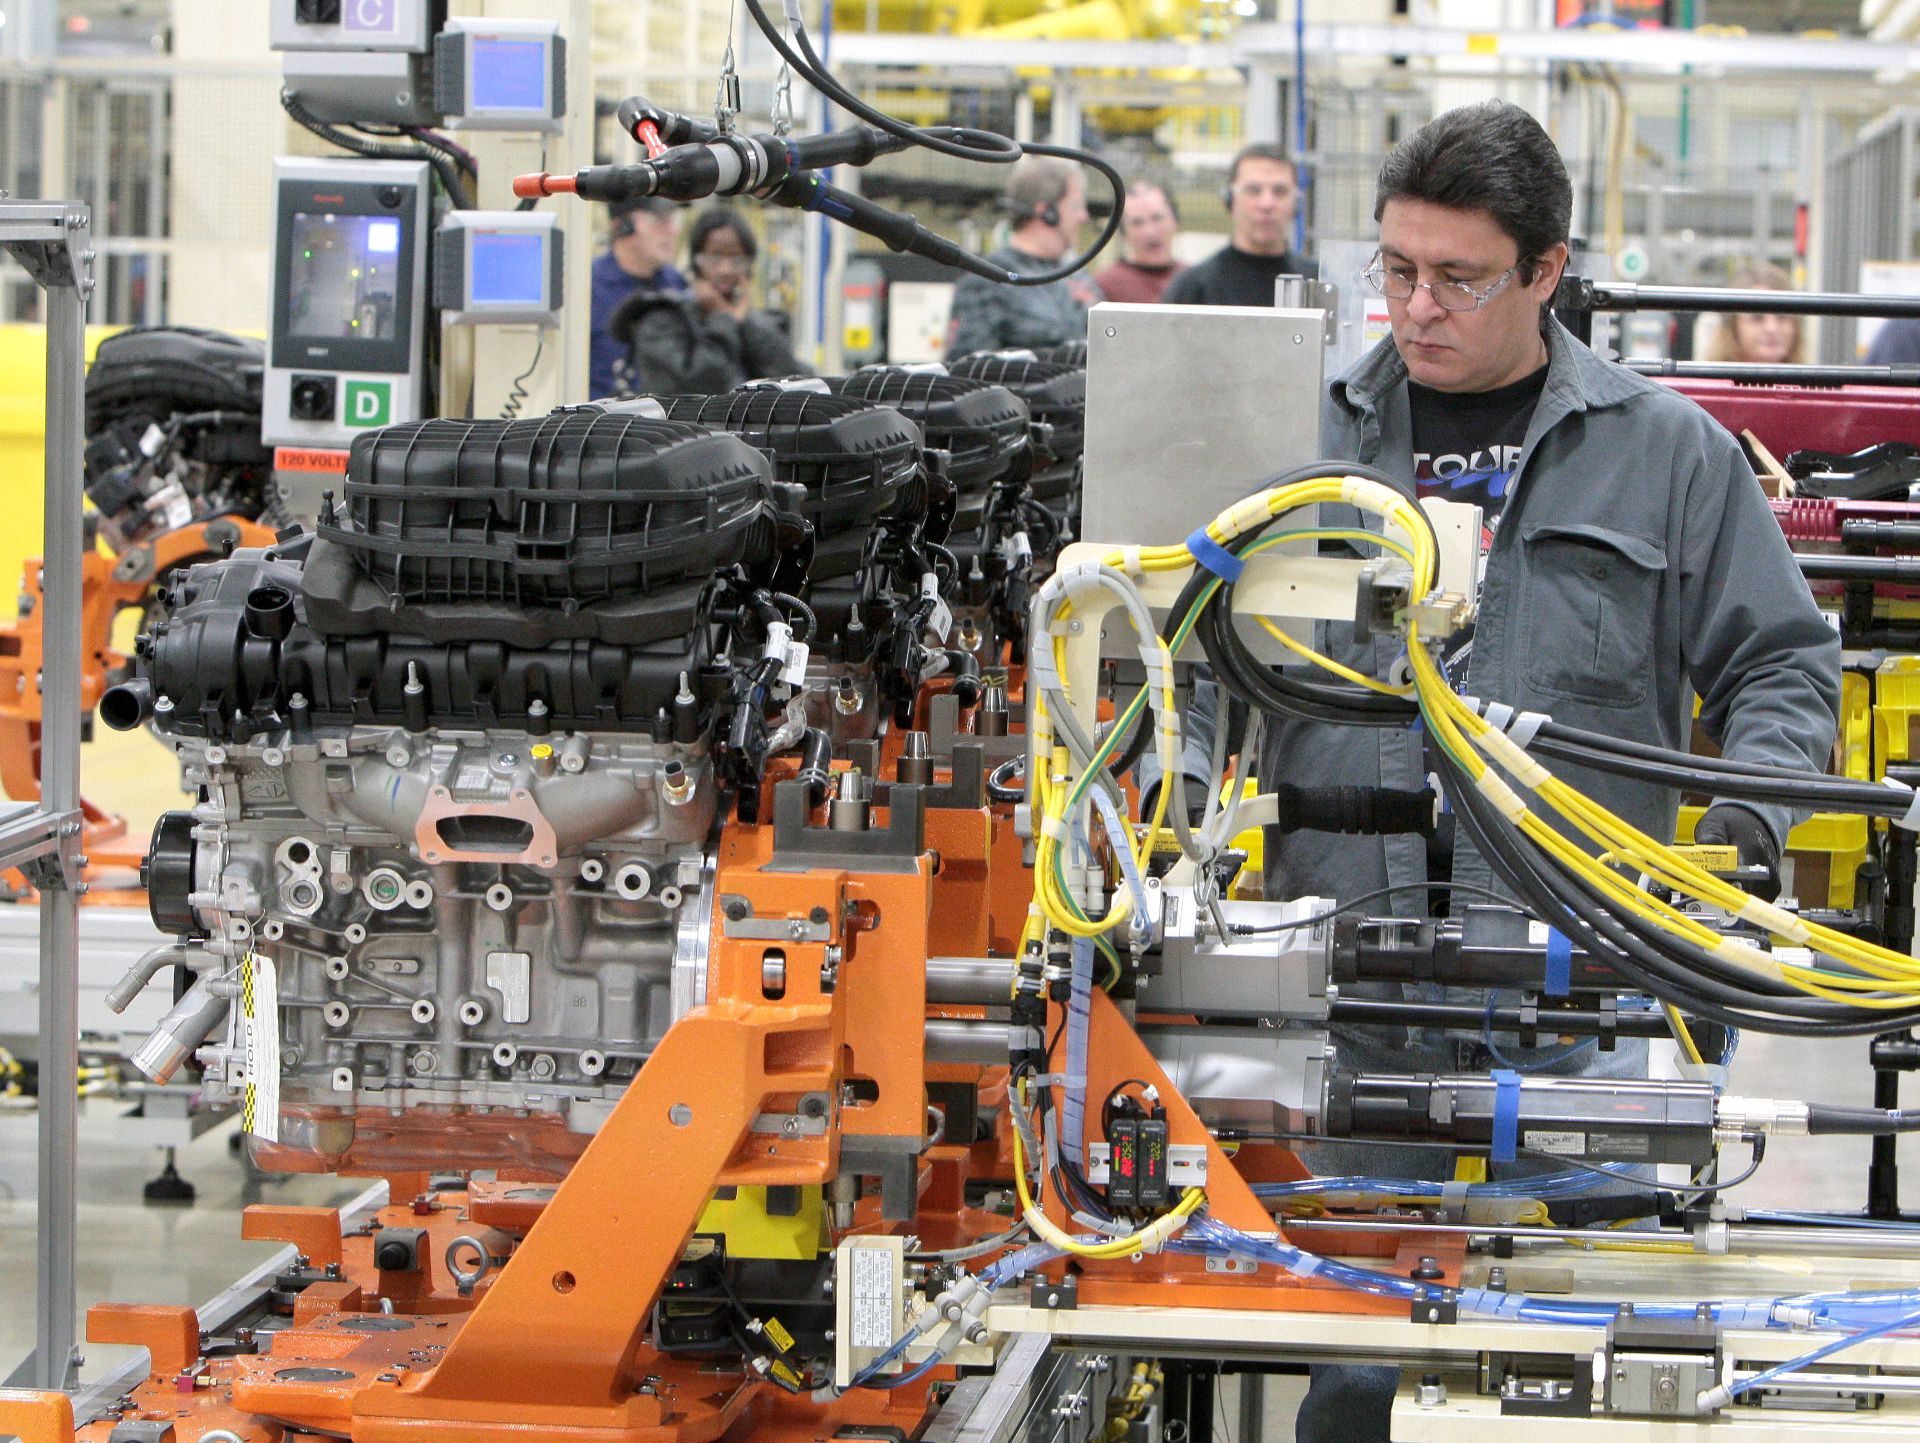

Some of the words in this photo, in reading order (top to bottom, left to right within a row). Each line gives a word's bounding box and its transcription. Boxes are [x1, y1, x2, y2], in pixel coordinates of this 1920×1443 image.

[356, 0, 383, 30] C
[355, 390, 380, 419] D
[281, 453, 305, 466] 120
[246, 1024, 254, 1076] HOLD
